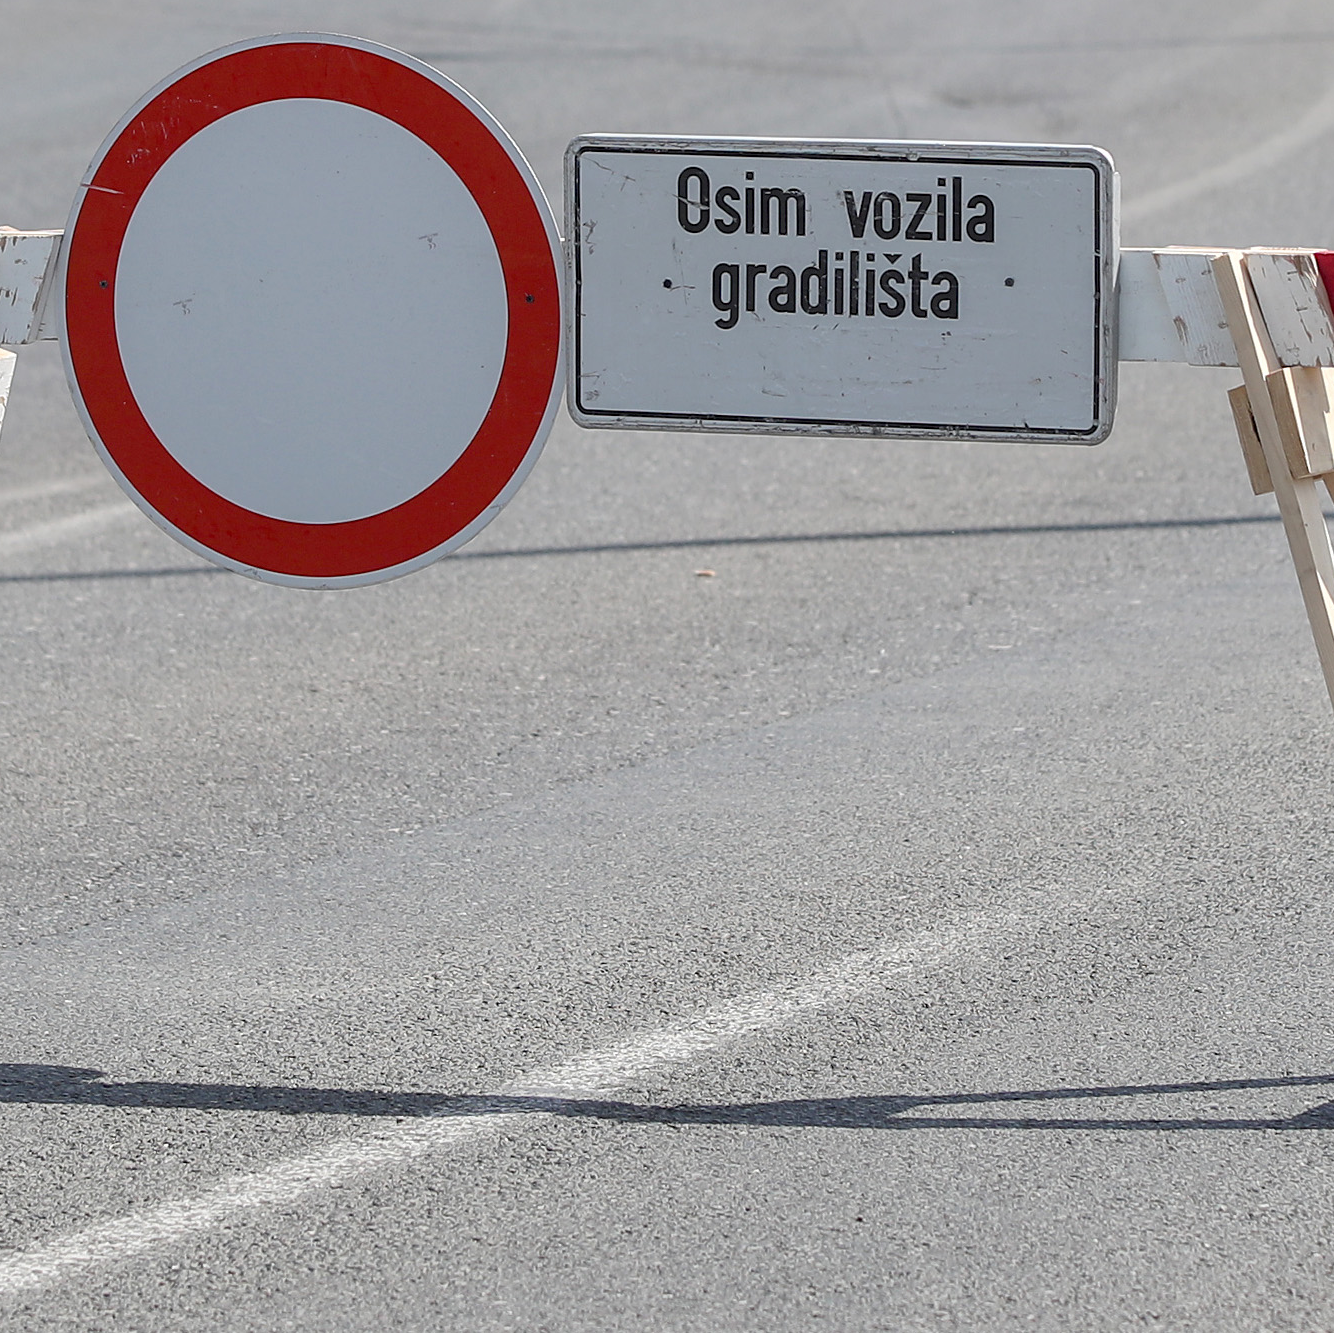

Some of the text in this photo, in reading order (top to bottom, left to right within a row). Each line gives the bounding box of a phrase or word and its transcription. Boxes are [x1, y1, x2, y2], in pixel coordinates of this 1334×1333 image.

[678, 166, 995, 243] Osim vozila
[712, 250, 960, 330] gradilišta
